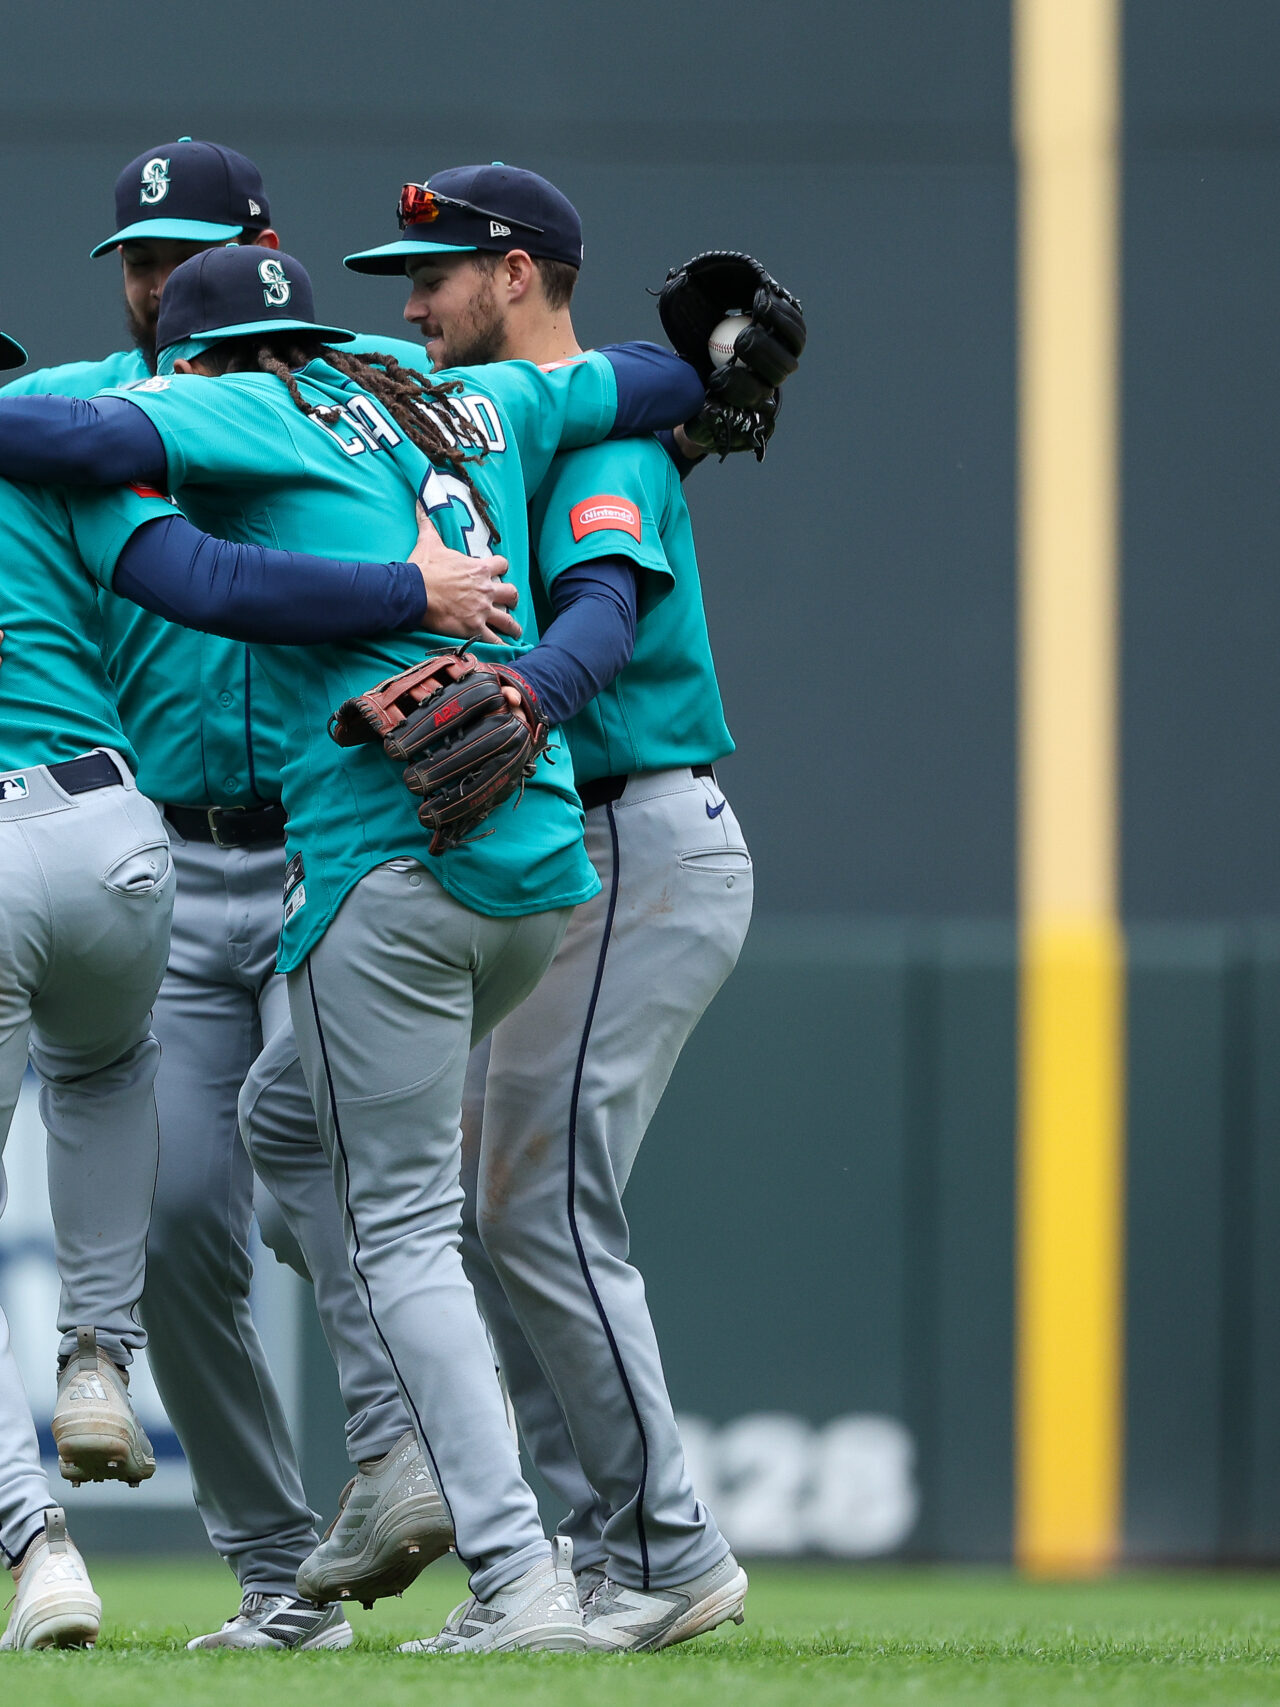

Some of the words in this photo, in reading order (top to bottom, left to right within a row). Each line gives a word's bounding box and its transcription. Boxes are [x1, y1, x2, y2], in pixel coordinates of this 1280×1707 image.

[140, 157, 171, 206] S
[257, 258, 291, 307] S
[583, 508, 633, 521] Nintendo
